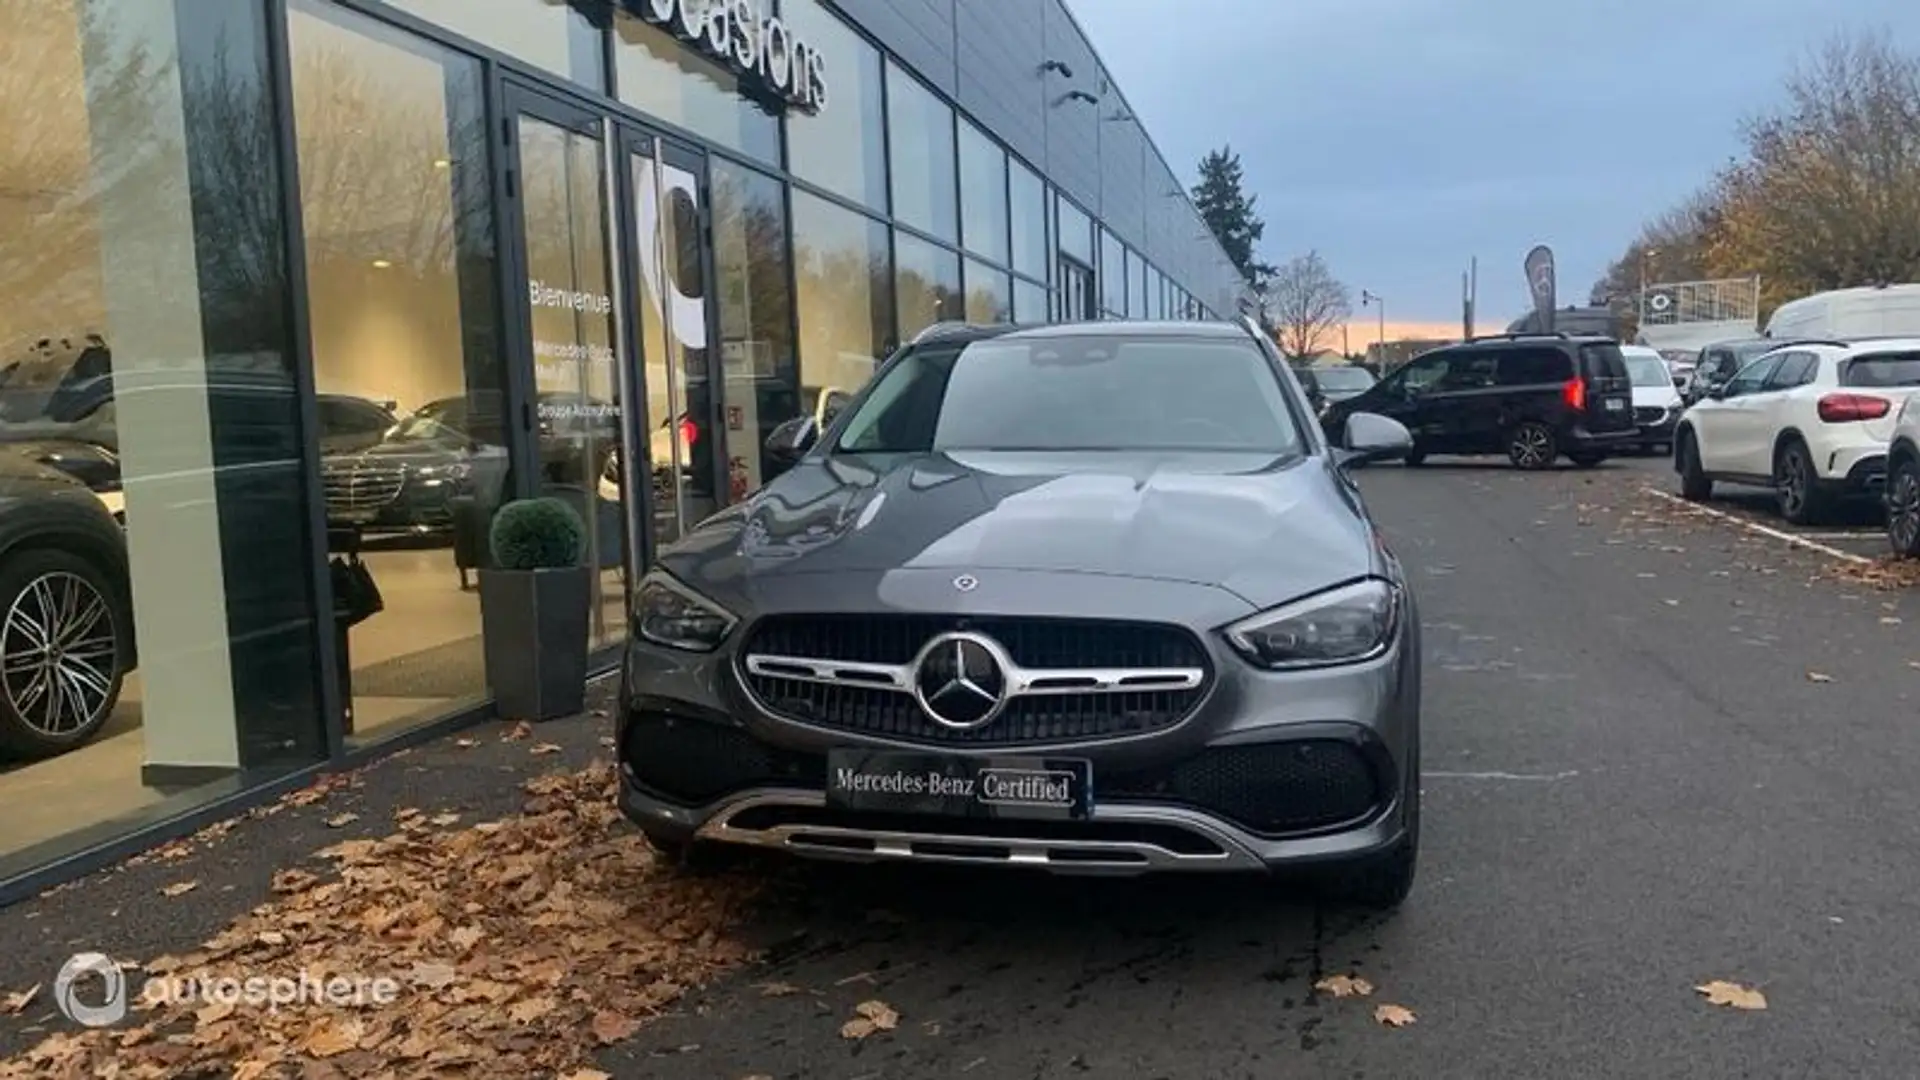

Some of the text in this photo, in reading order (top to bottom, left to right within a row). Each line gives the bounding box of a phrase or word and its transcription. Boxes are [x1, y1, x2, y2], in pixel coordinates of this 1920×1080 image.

[529, 280, 612, 314] Bienvenue
[836, 767, 1070, 801] Mercedes-Benz Certified
